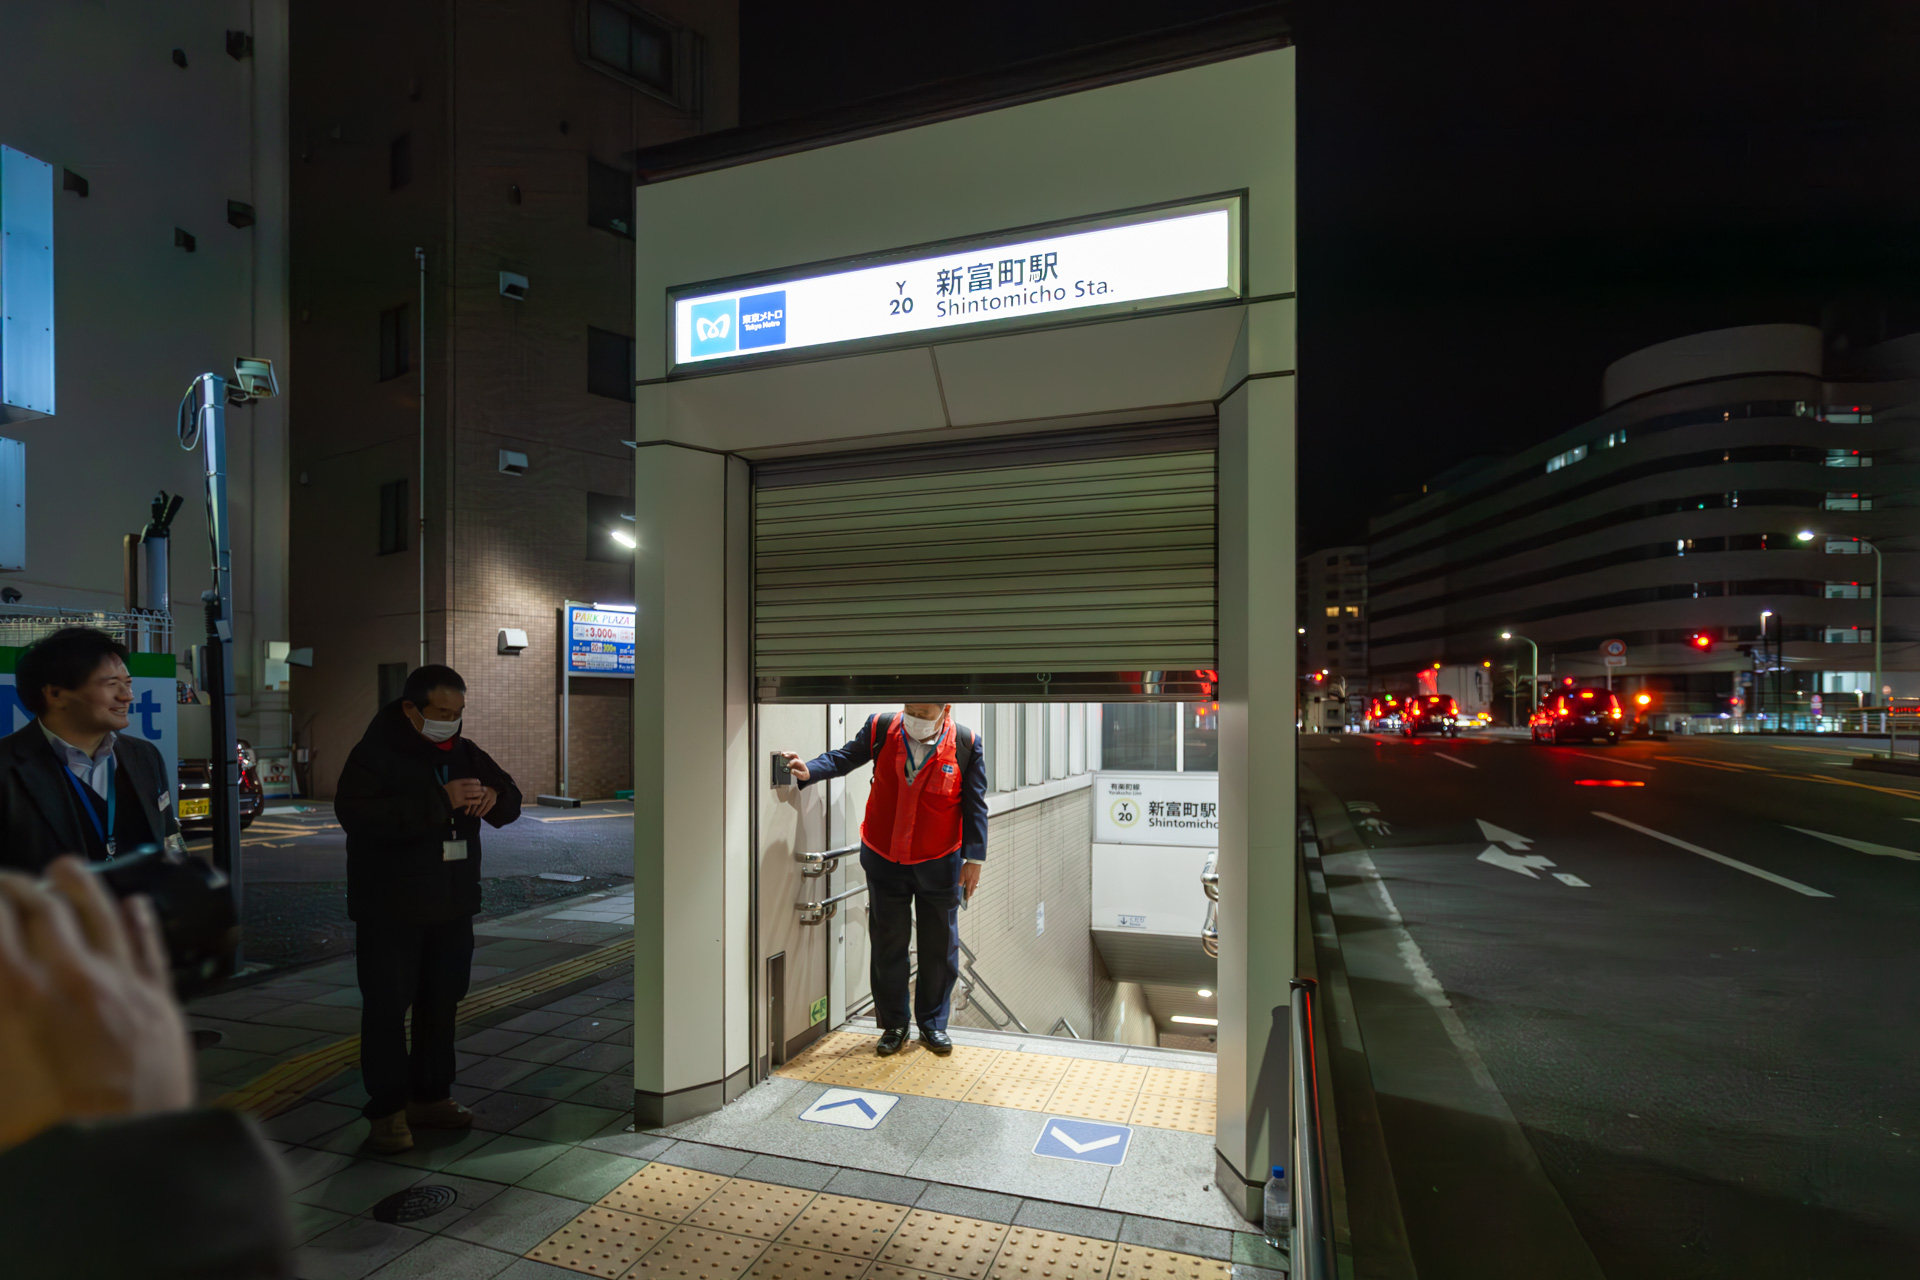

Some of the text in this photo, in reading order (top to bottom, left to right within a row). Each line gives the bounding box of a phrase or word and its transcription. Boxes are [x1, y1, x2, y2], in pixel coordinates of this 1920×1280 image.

[936, 251, 1058, 297] 新富町駅
[895, 280, 907, 296] Y
[889, 297, 914, 316] 20
[936, 279, 1114, 318] Shintomicho Sta.
[742, 309, 783, 325] 東京メトロ
[574, 612, 630, 625] PARK PLAZA
[1110, 783, 1141, 791] 有楽町線
[1121, 803, 1129, 811] Y
[1148, 801, 1217, 818] 新富町駅
[1118, 812, 1133, 822] 20
